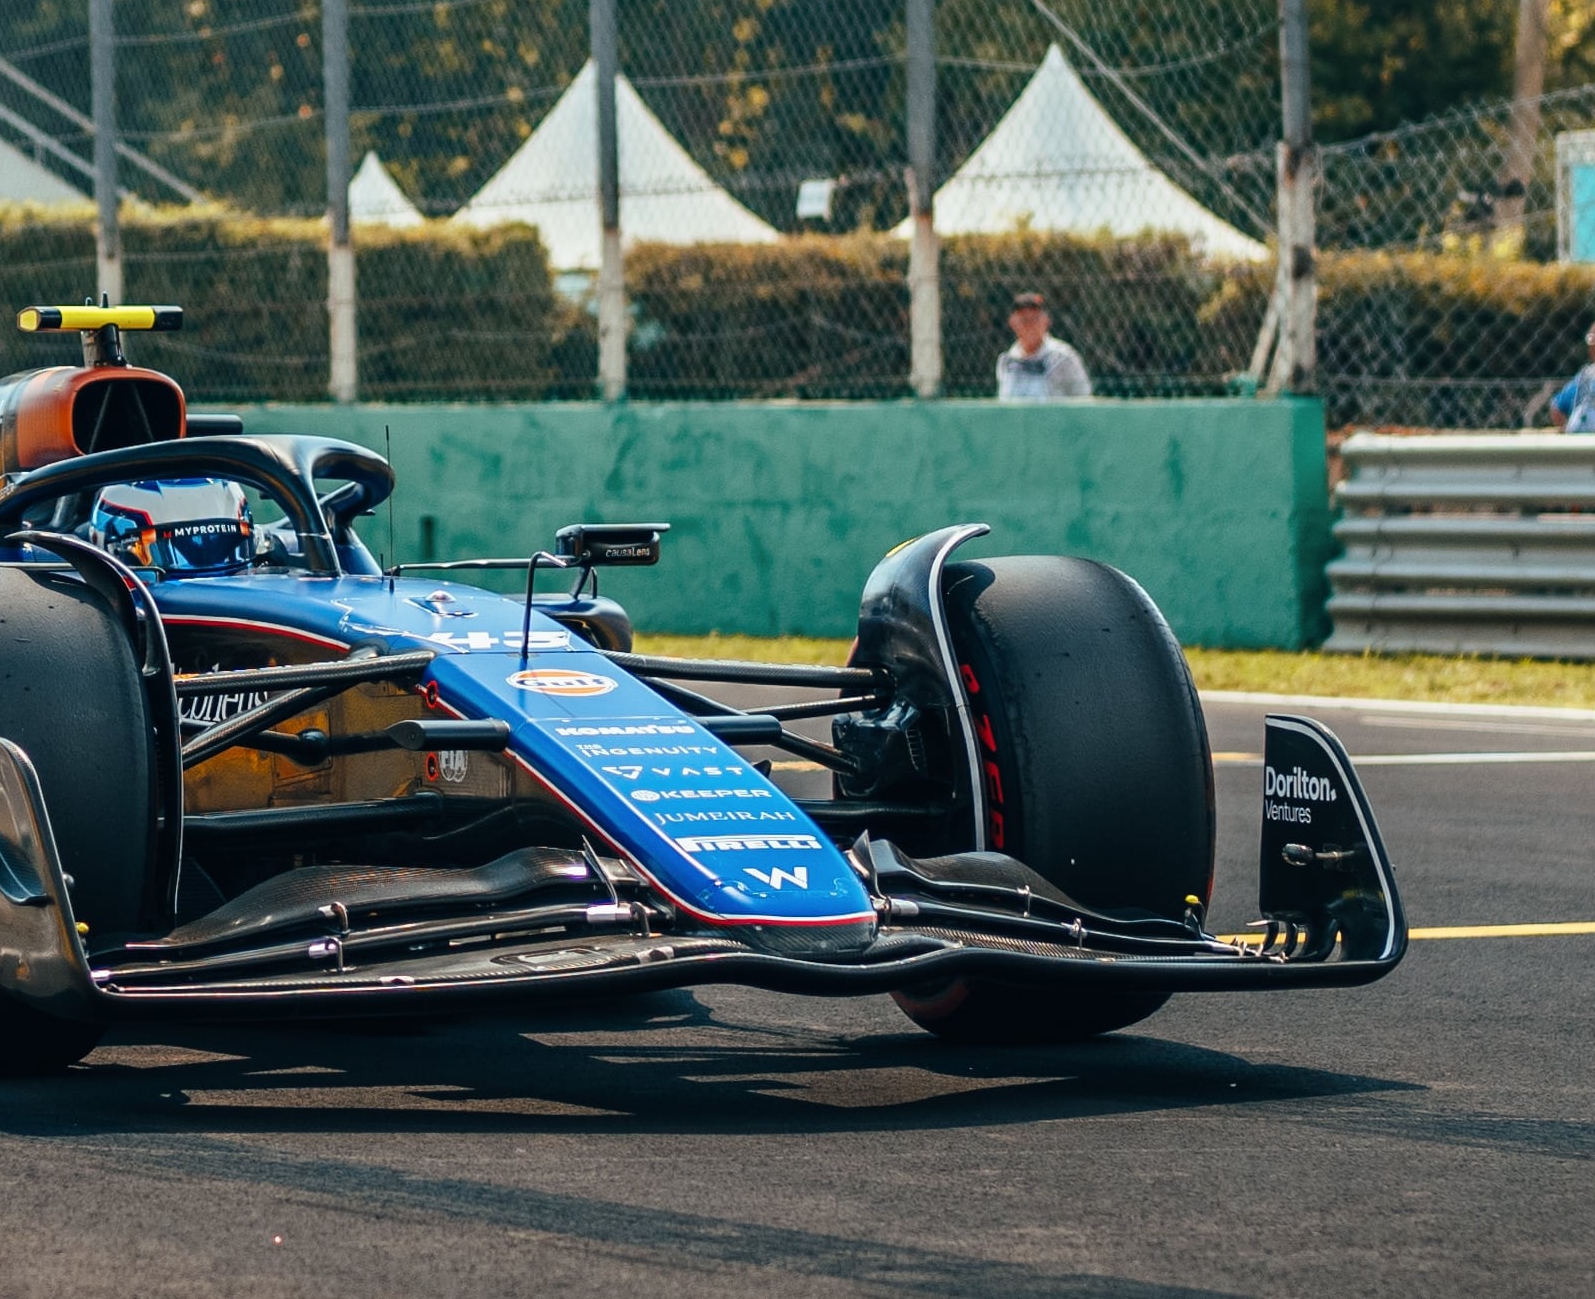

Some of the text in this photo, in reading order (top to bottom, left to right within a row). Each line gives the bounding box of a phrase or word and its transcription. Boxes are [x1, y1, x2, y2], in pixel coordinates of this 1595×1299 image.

[175, 524, 237, 537] MYPROTEIN
[516, 678, 605, 687] Gulf
[556, 724, 695, 736] KOMATSU
[581, 746, 718, 758] INGENUITY
[652, 766, 743, 775] VAST
[661, 789, 772, 798] KEEPER
[1266, 799, 1311, 824] Ventures
[655, 811, 796, 825] JUMEIRAH
[674, 834, 823, 852] PIRELLI
[742, 866, 808, 890] W
